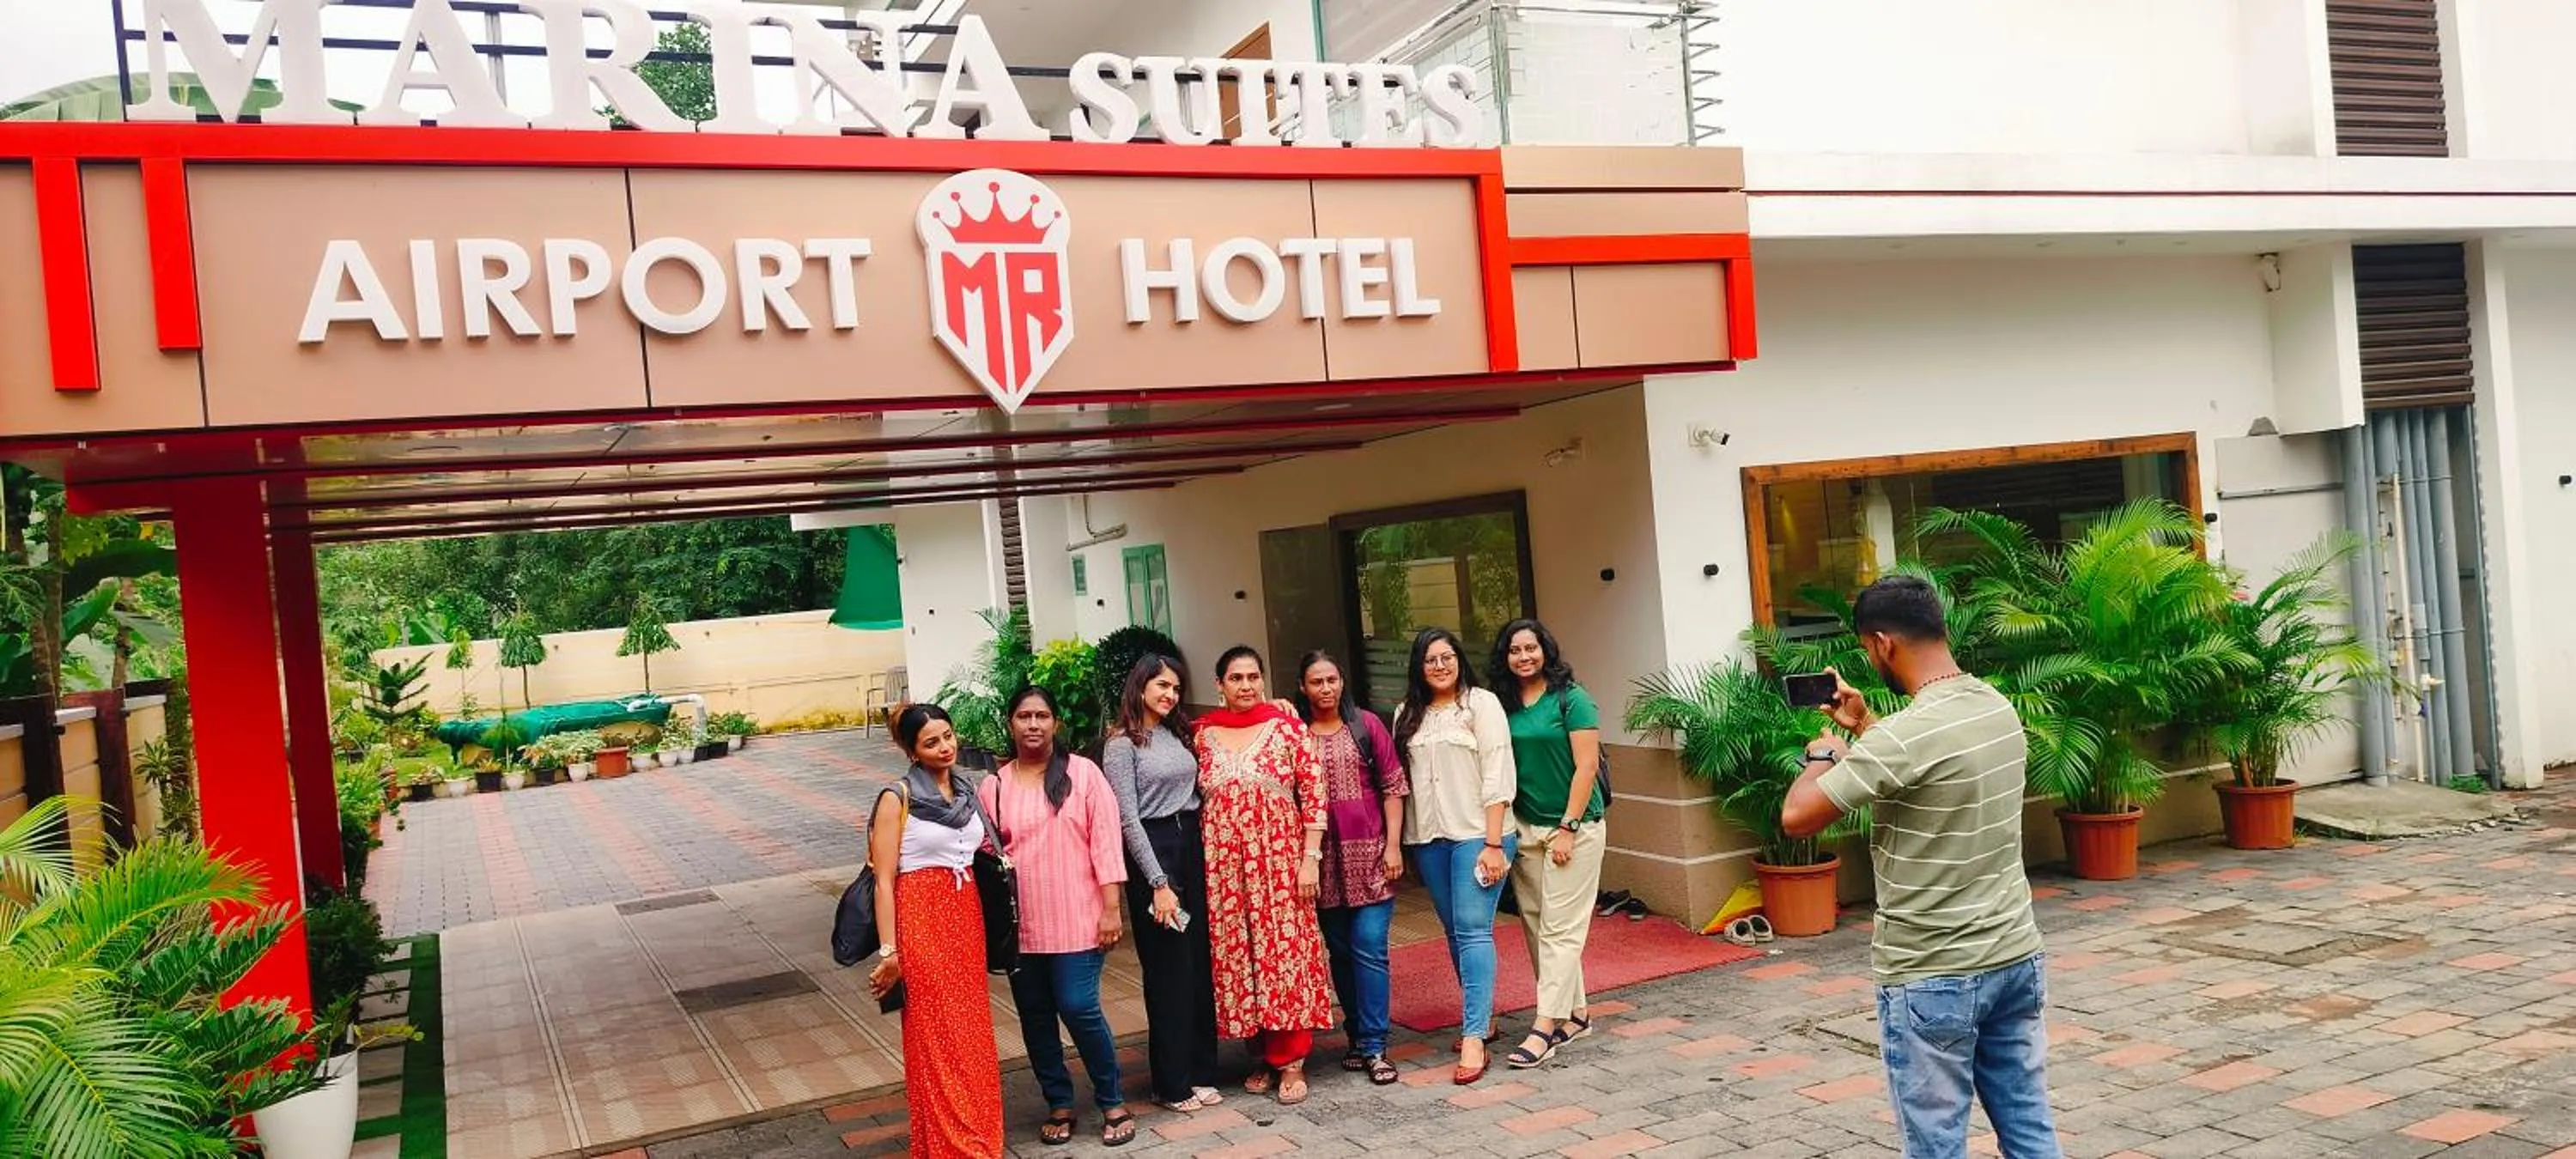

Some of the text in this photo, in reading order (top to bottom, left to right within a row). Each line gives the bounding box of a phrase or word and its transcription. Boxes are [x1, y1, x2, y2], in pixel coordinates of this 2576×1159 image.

[127, 0, 1482, 149] MARINA SUITES
[298, 238, 872, 343] AIRPORT
[941, 252, 1063, 393] MR
[1120, 238, 1442, 324] HOTEL
